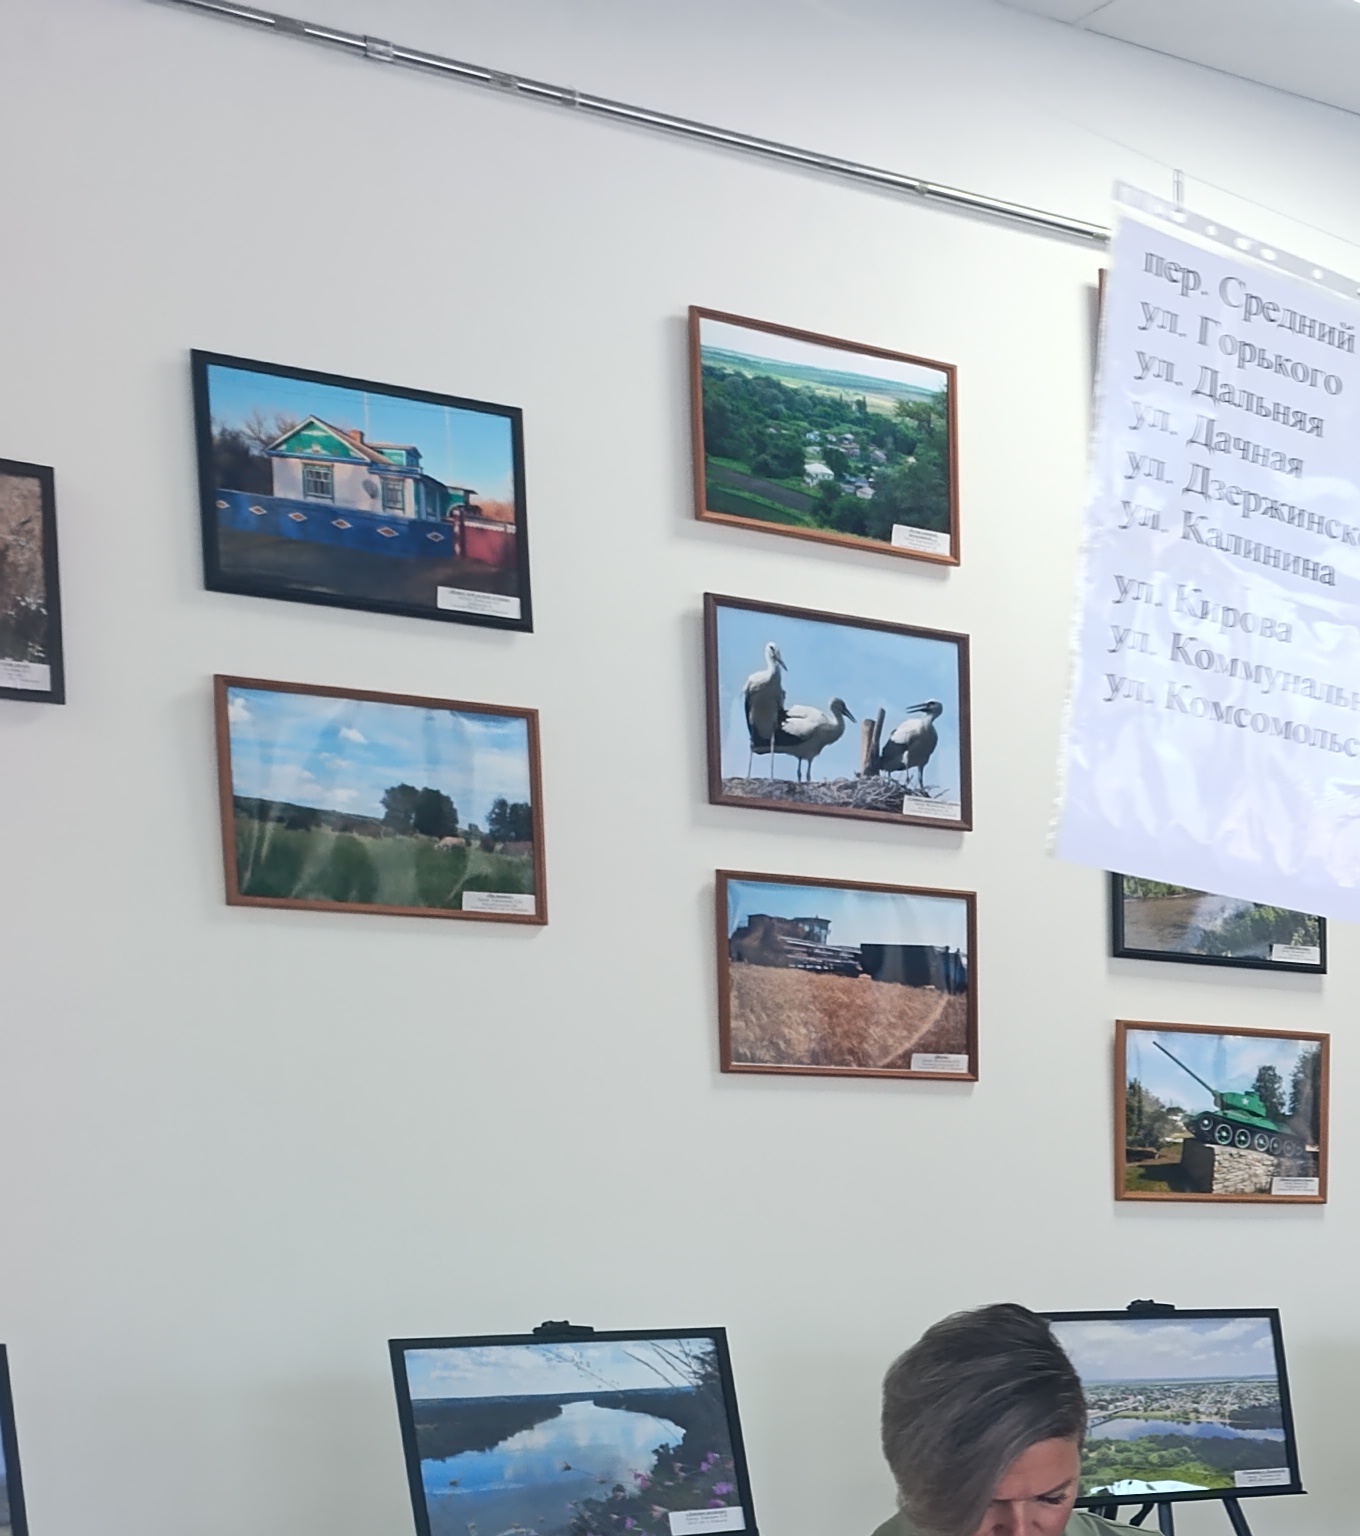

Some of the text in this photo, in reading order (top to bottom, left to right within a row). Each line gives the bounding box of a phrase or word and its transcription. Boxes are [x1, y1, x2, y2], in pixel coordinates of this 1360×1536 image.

[1143, 250, 1356, 353] пер. Средний
[1137, 301, 1343, 396] ул. Горького
[1133, 350, 1324, 438] ул. Дальняя
[1124, 449, 1174, 484] ул.
[1128, 401, 1304, 479] ул. Дачная
[1118, 500, 1337, 587] ул. Калинина
[1106, 624, 1156, 655] ул.
[1112, 574, 1293, 643] ул. Кирова
[1103, 672, 1154, 703] ул.
